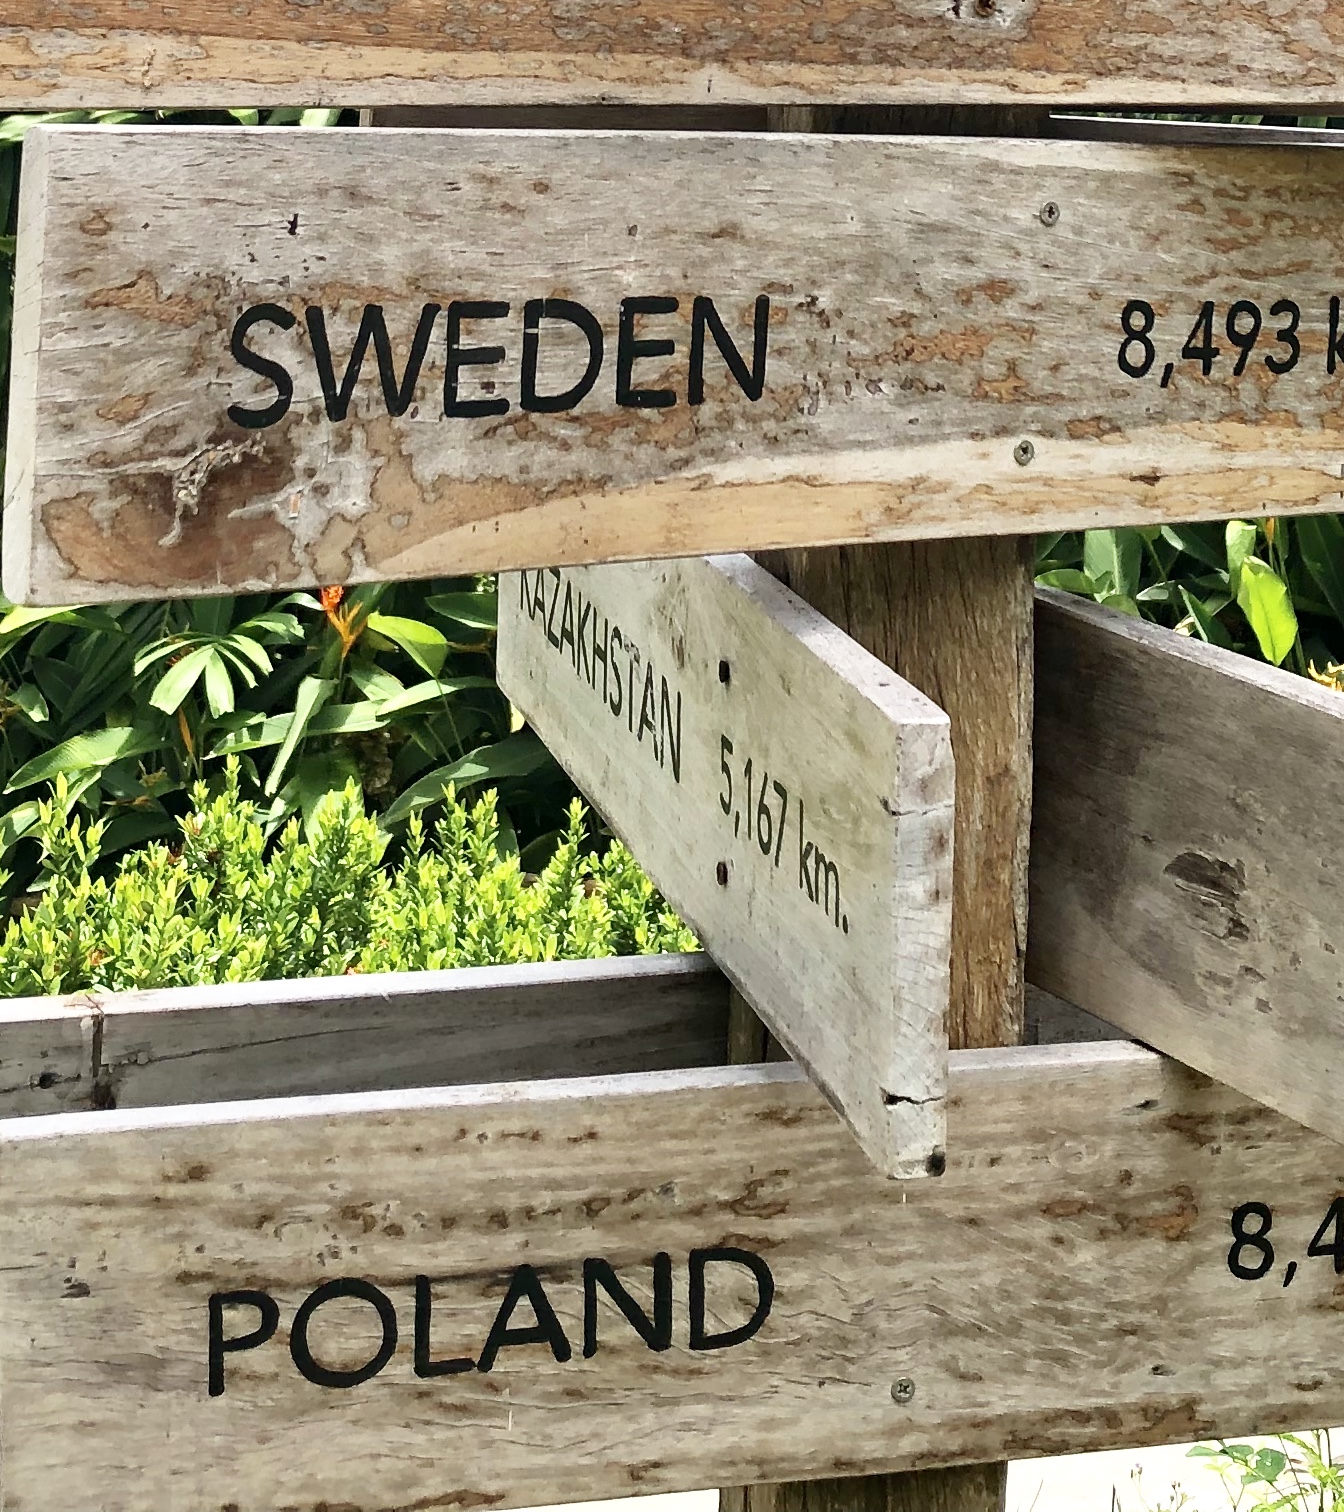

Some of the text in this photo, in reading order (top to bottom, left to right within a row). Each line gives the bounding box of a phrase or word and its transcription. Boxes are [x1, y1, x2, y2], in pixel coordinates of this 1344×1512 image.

[226, 294, 771, 430] SWEDEN
[1117, 298, 1302, 389] 8,493
[718, 734, 789, 869] 5,167
[798, 798, 849, 935] km.
[207, 1246, 776, 1398] POLAND
